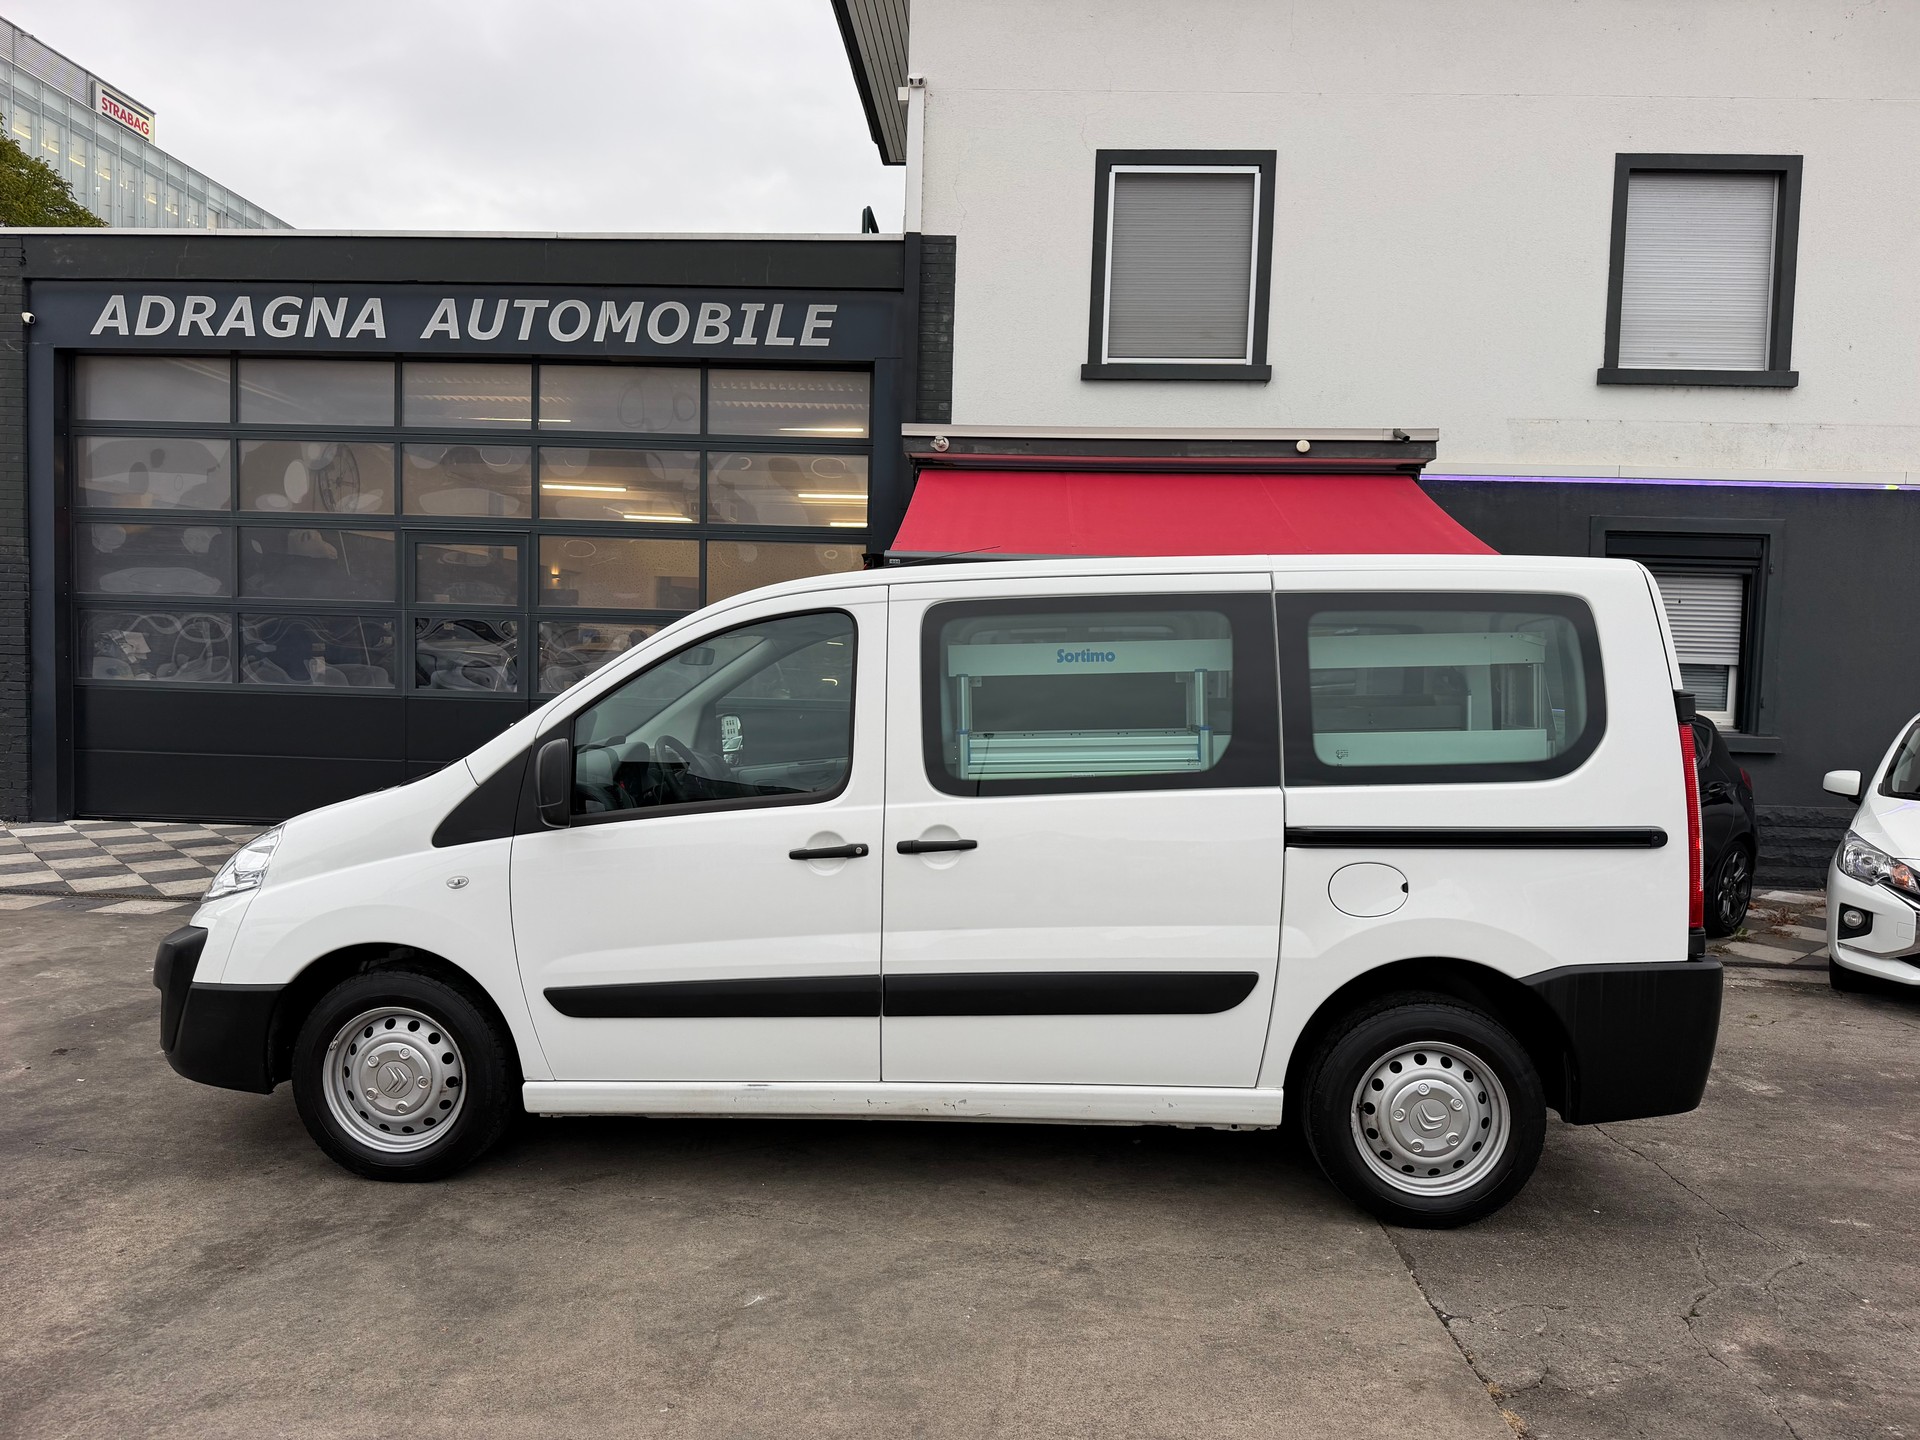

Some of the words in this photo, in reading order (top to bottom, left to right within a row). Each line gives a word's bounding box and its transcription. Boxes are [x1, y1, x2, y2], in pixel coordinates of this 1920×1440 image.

[101, 97, 150, 135] STRABAG
[90, 295, 386, 338] ADRAGNA
[420, 298, 838, 347] AUTOMOBILE
[1057, 648, 1116, 664] Sortimo
